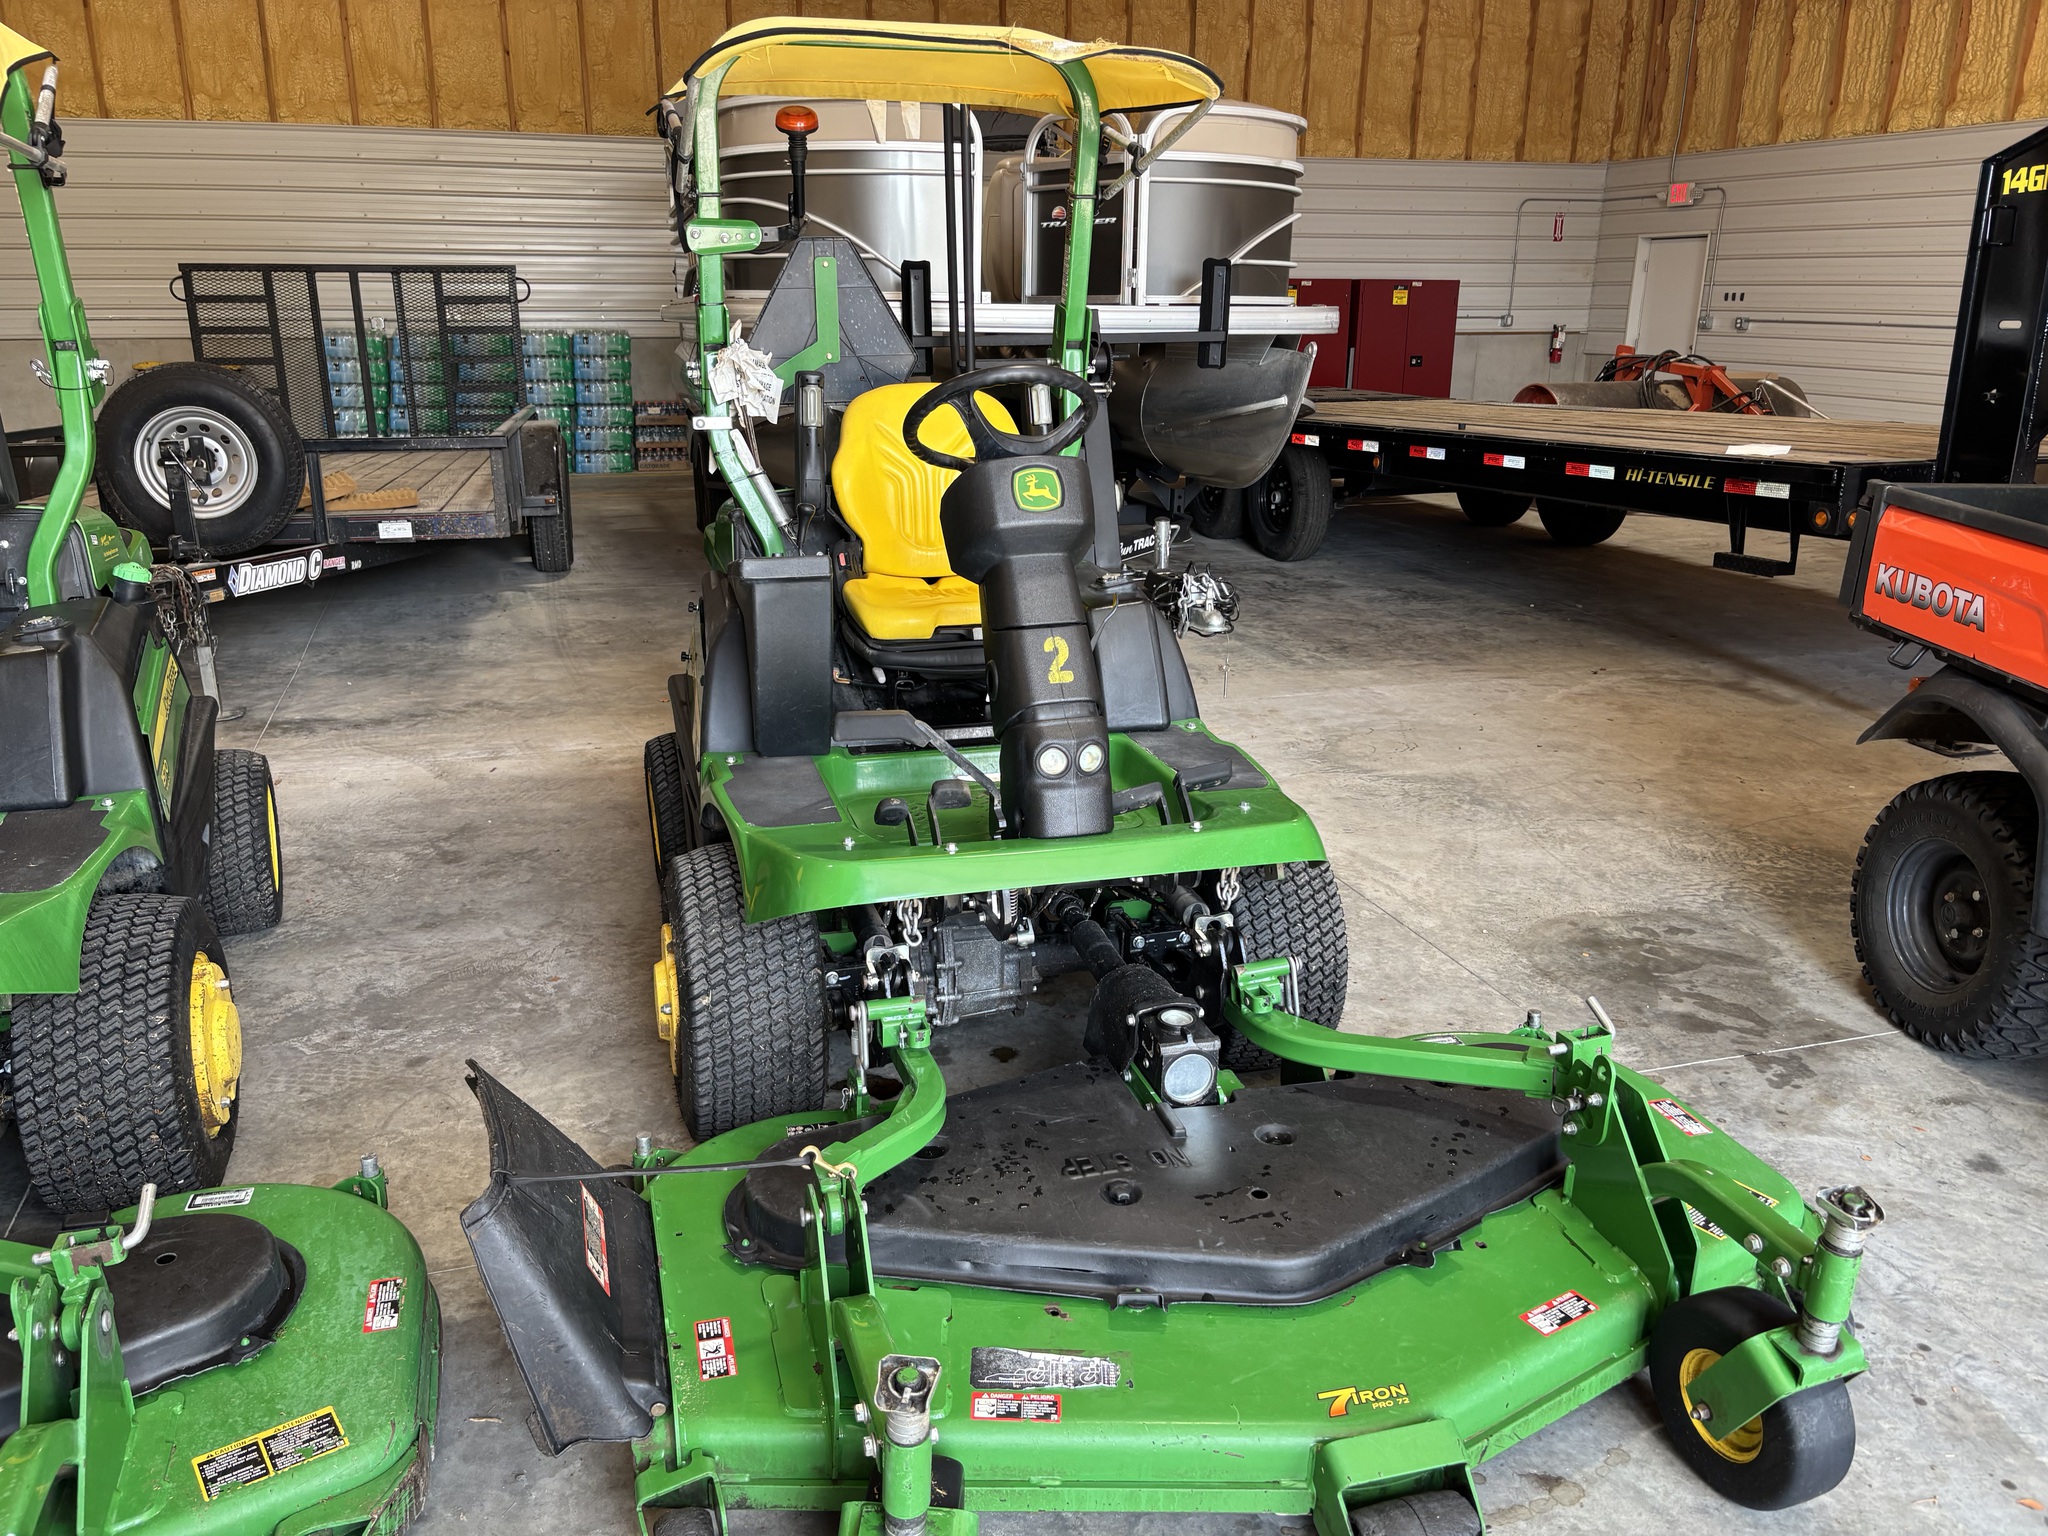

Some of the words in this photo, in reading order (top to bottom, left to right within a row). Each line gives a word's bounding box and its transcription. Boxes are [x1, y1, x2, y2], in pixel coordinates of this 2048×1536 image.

[1041, 217, 1117, 228] TRAER
[1625, 468, 1716, 490] HI-TENSILE
[238, 556, 307, 596] DIAMOND
[309, 549, 323, 581] C
[1874, 562, 1985, 632] KUBOTA
[1043, 636, 1074, 684] 2
[1147, 1147, 1193, 1168] NO
[1372, 1400, 1394, 1410] PRO
[1396, 1397, 1410, 1405] 72
[214, 1440, 247, 1456] CAUTION
